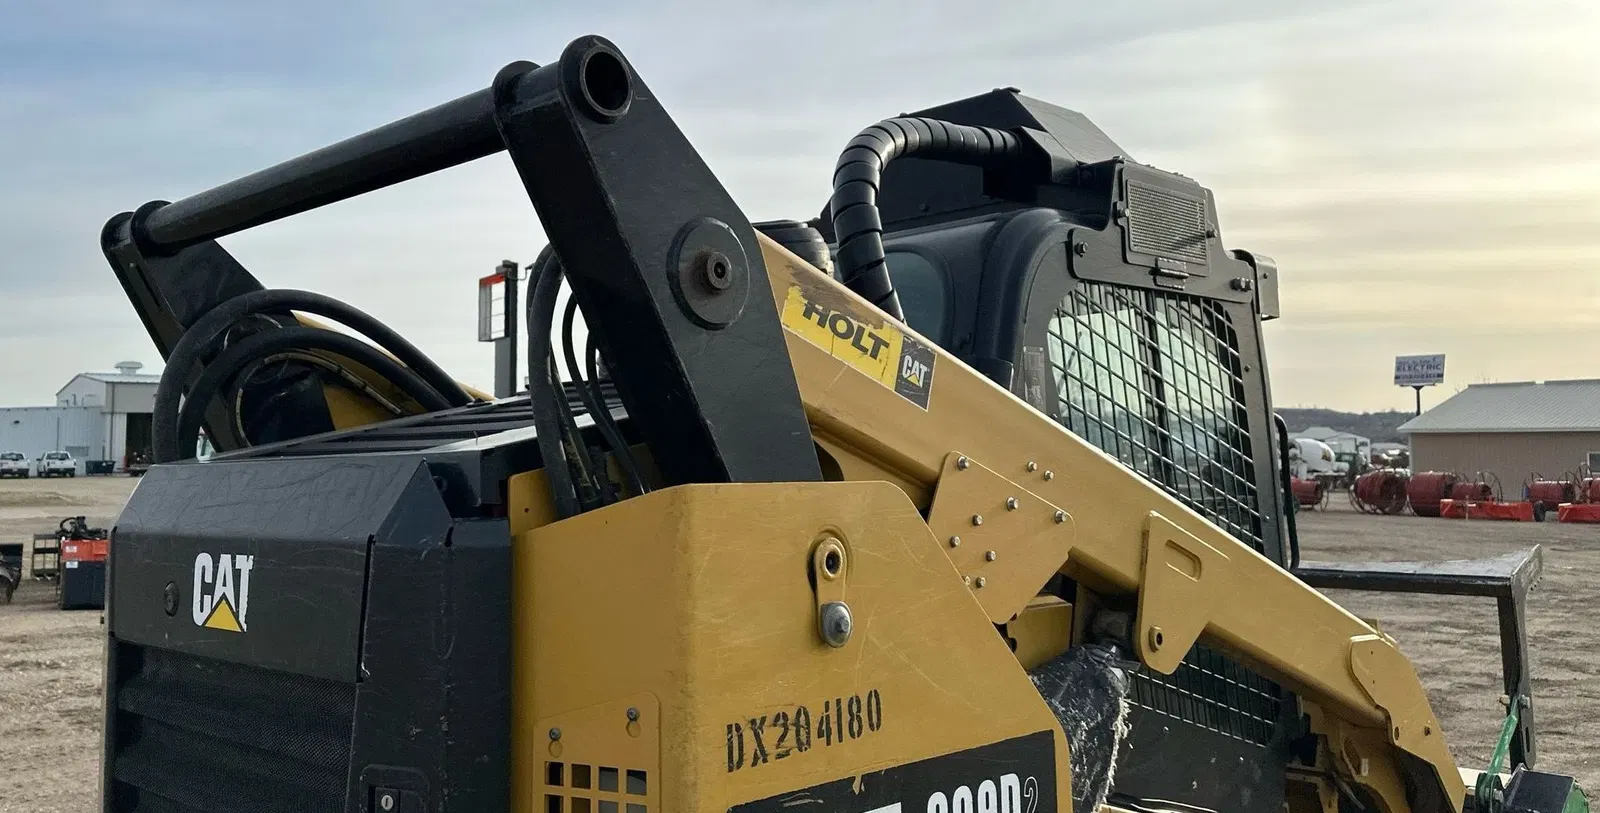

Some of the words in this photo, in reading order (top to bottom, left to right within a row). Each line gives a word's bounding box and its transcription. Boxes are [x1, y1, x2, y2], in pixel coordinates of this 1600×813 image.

[802, 301, 890, 361] HOLT
[902, 355, 928, 388] CAT
[192, 552, 254, 632] CAT
